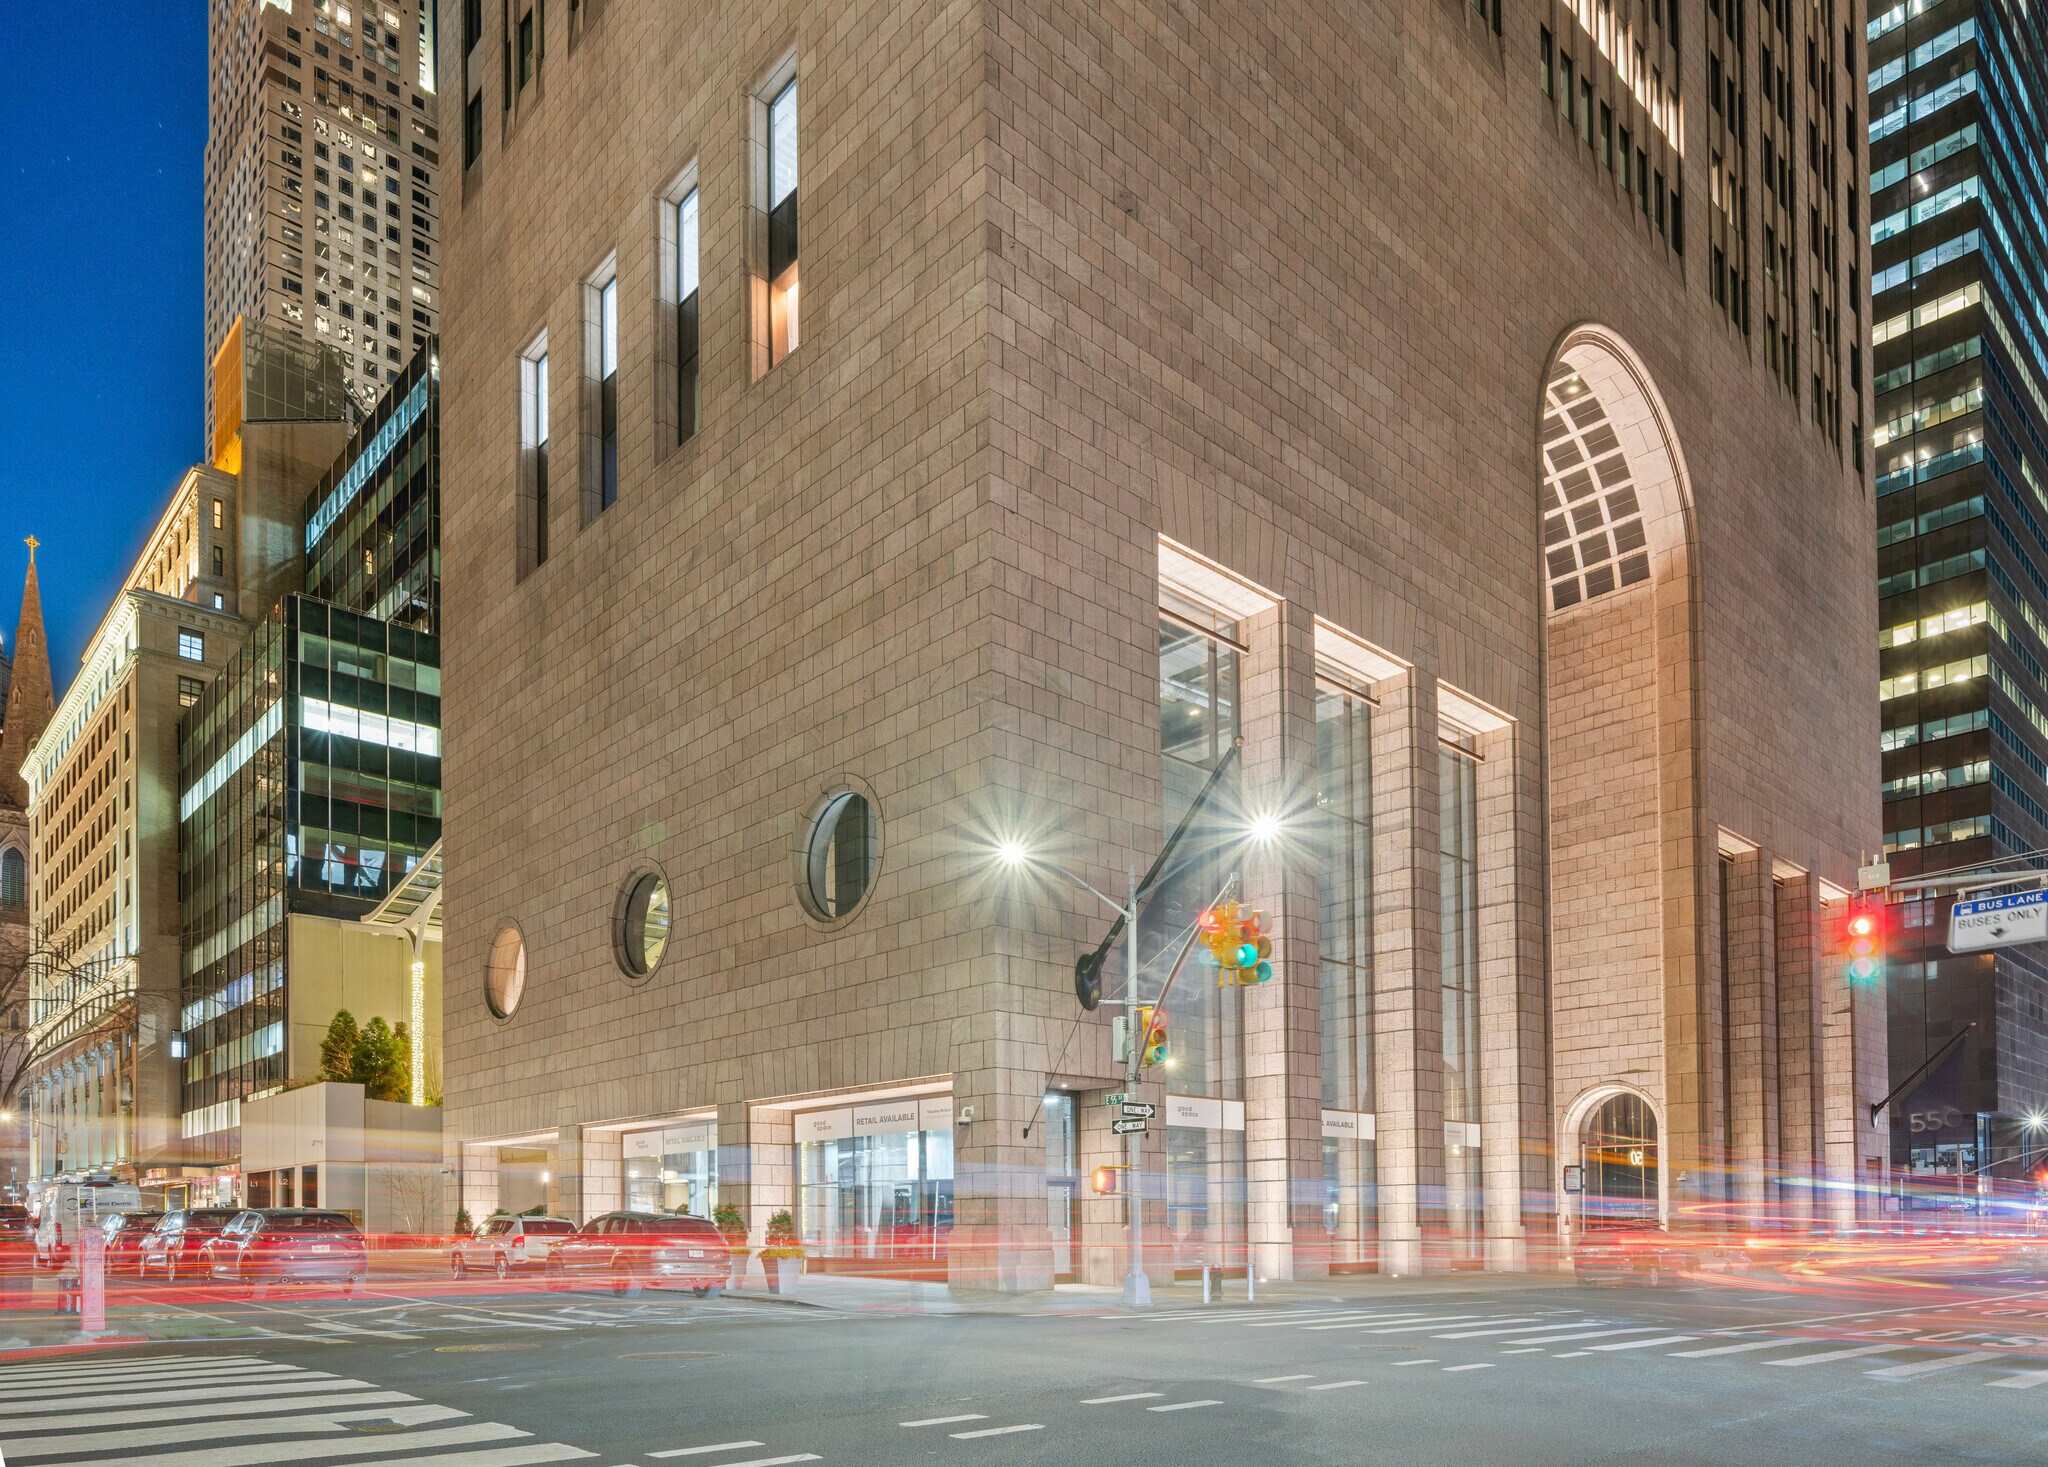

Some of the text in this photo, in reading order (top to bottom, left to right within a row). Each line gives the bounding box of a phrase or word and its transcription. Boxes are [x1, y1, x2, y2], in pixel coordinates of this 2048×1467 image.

[1978, 893, 2043, 911] BUS LANE
[1959, 908, 2042, 928] BUSES ONLY
[856, 1113, 915, 1126] RETAIL AVAILABLE
[682, 1135, 705, 1143] AVAILABLE
[1840, 1327, 2048, 1348] BUS
